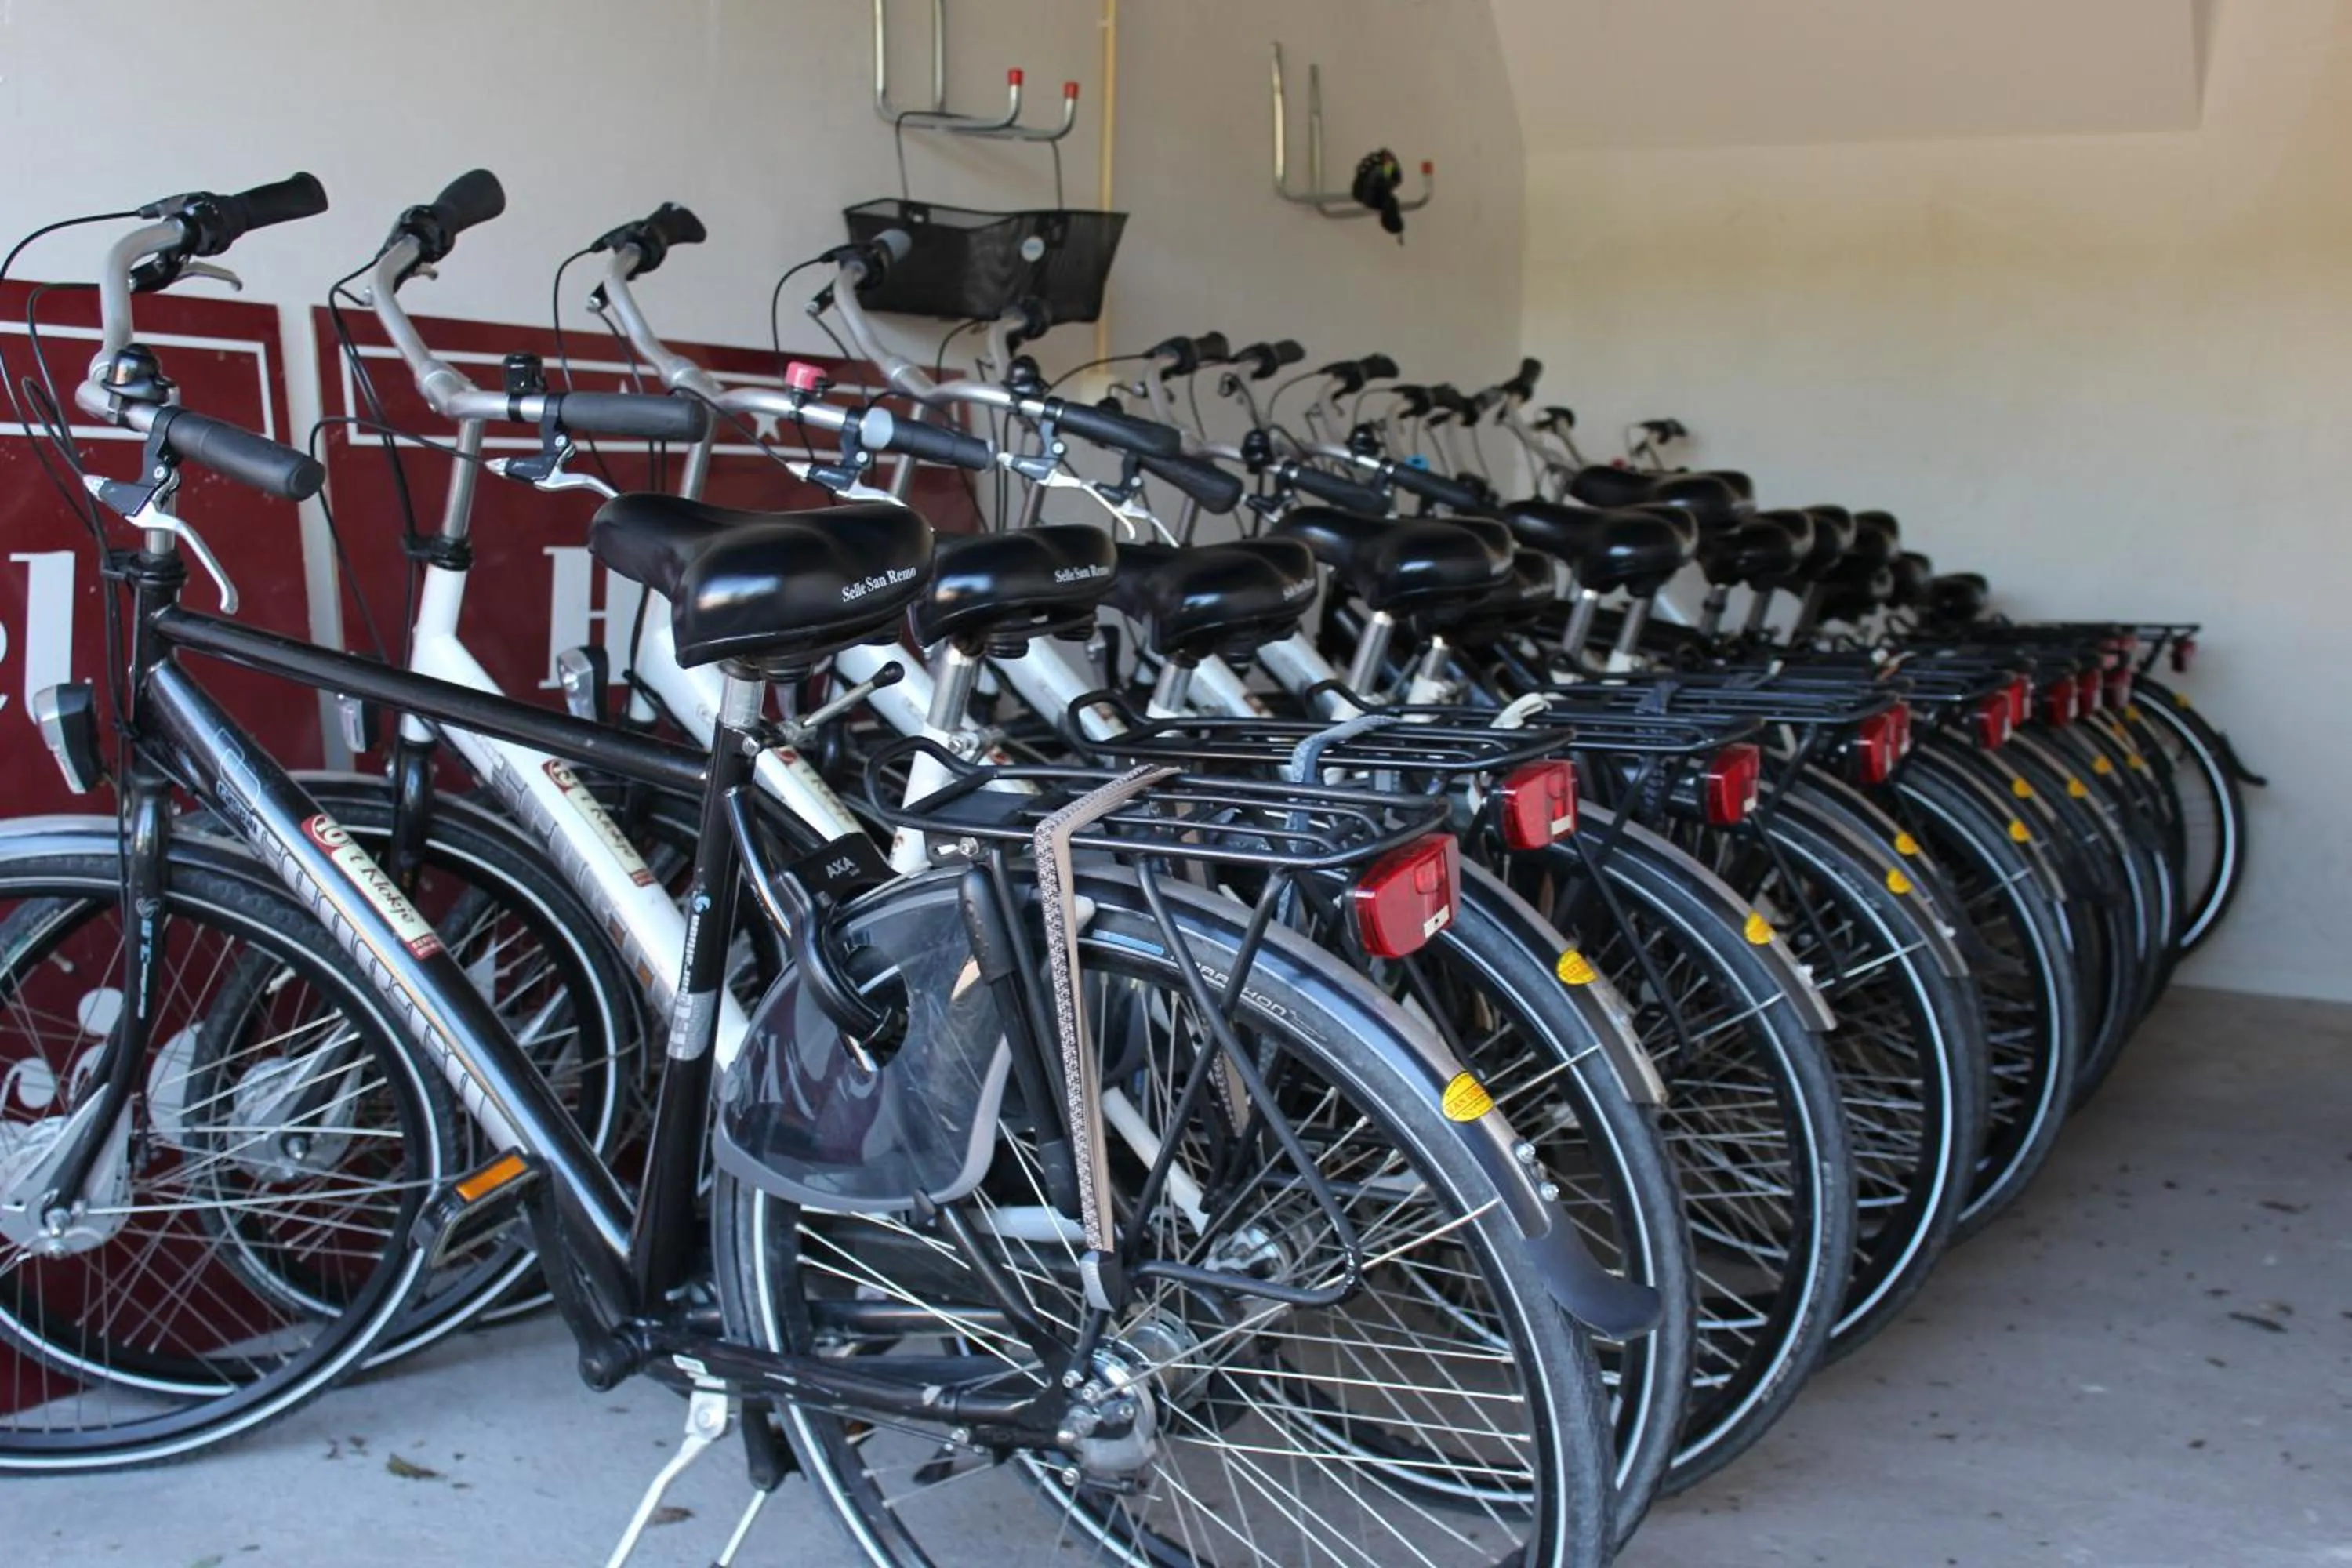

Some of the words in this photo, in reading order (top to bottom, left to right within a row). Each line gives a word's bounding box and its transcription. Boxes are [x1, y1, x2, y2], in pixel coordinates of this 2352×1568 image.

[840, 582, 866, 602] Selle
[865, 577, 887, 592] San
[886, 566, 916, 584] Remo
[826, 856, 855, 879] AXA
[360, 866, 416, 924] Klokje
